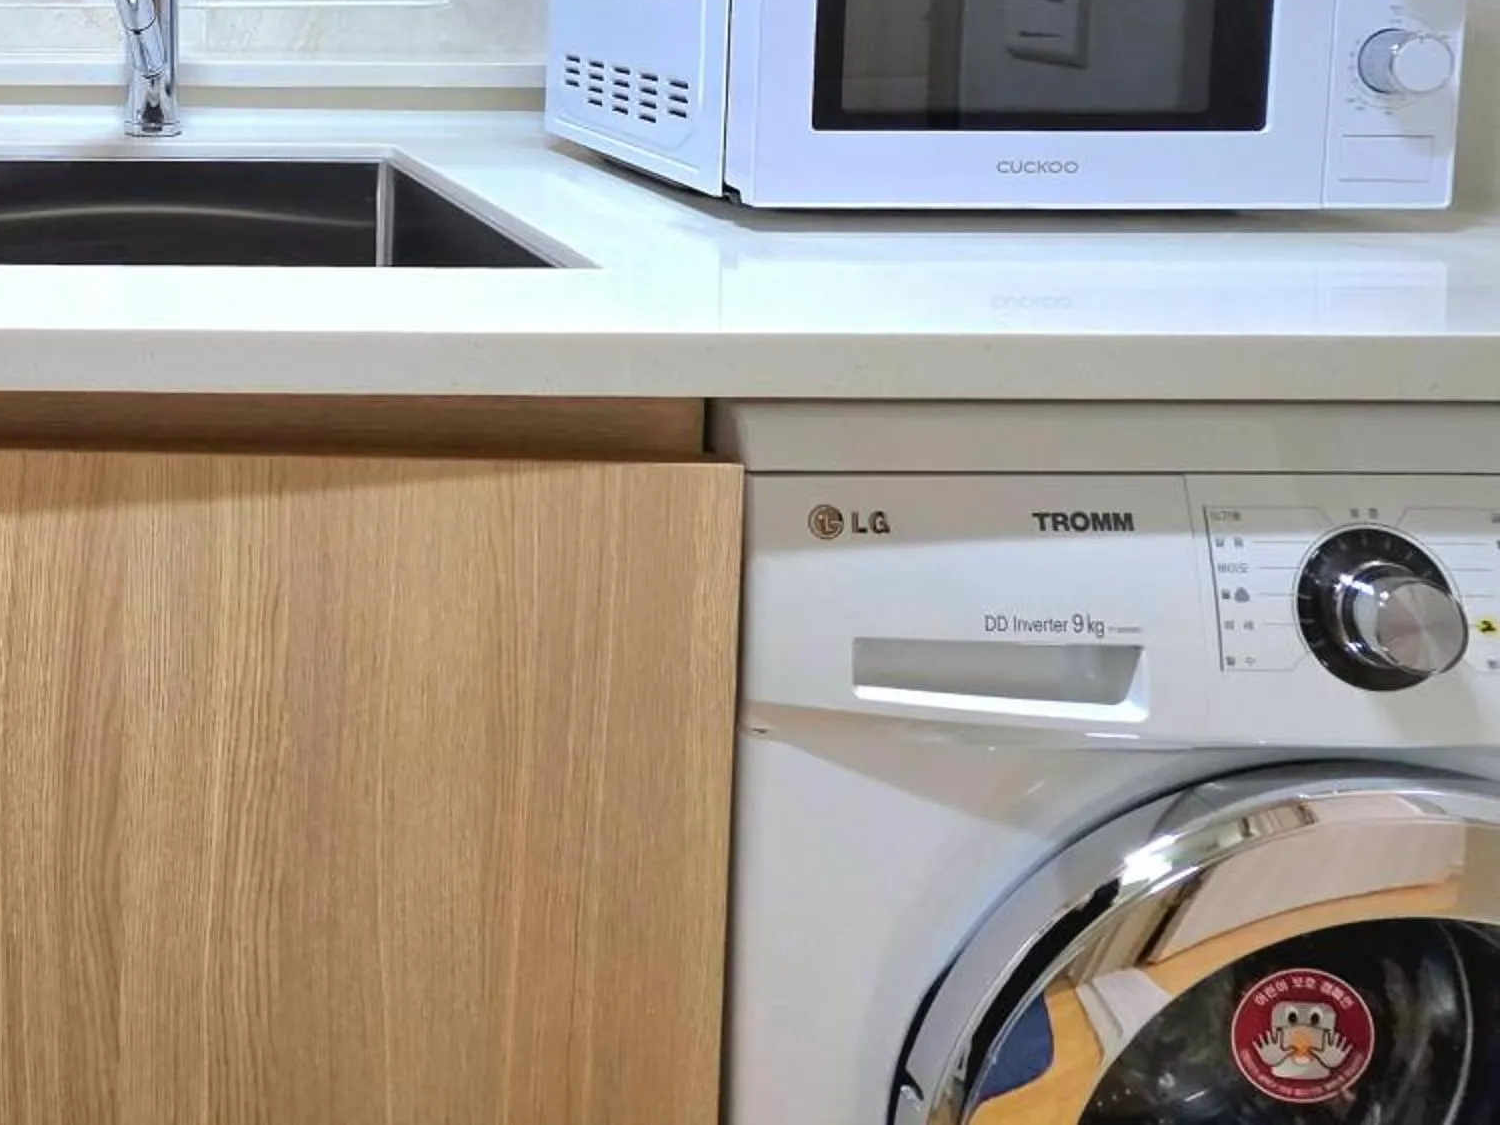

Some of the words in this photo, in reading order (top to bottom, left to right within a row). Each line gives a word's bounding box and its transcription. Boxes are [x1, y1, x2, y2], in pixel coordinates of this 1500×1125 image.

[996, 160, 1079, 174] CUCKOO
[851, 511, 891, 534] LG
[1032, 512, 1135, 532] TROMM
[984, 615, 1008, 632] DD
[1013, 616, 1068, 633] Inverter
[1072, 613, 1085, 634] 9
[1087, 613, 1105, 638] kg
